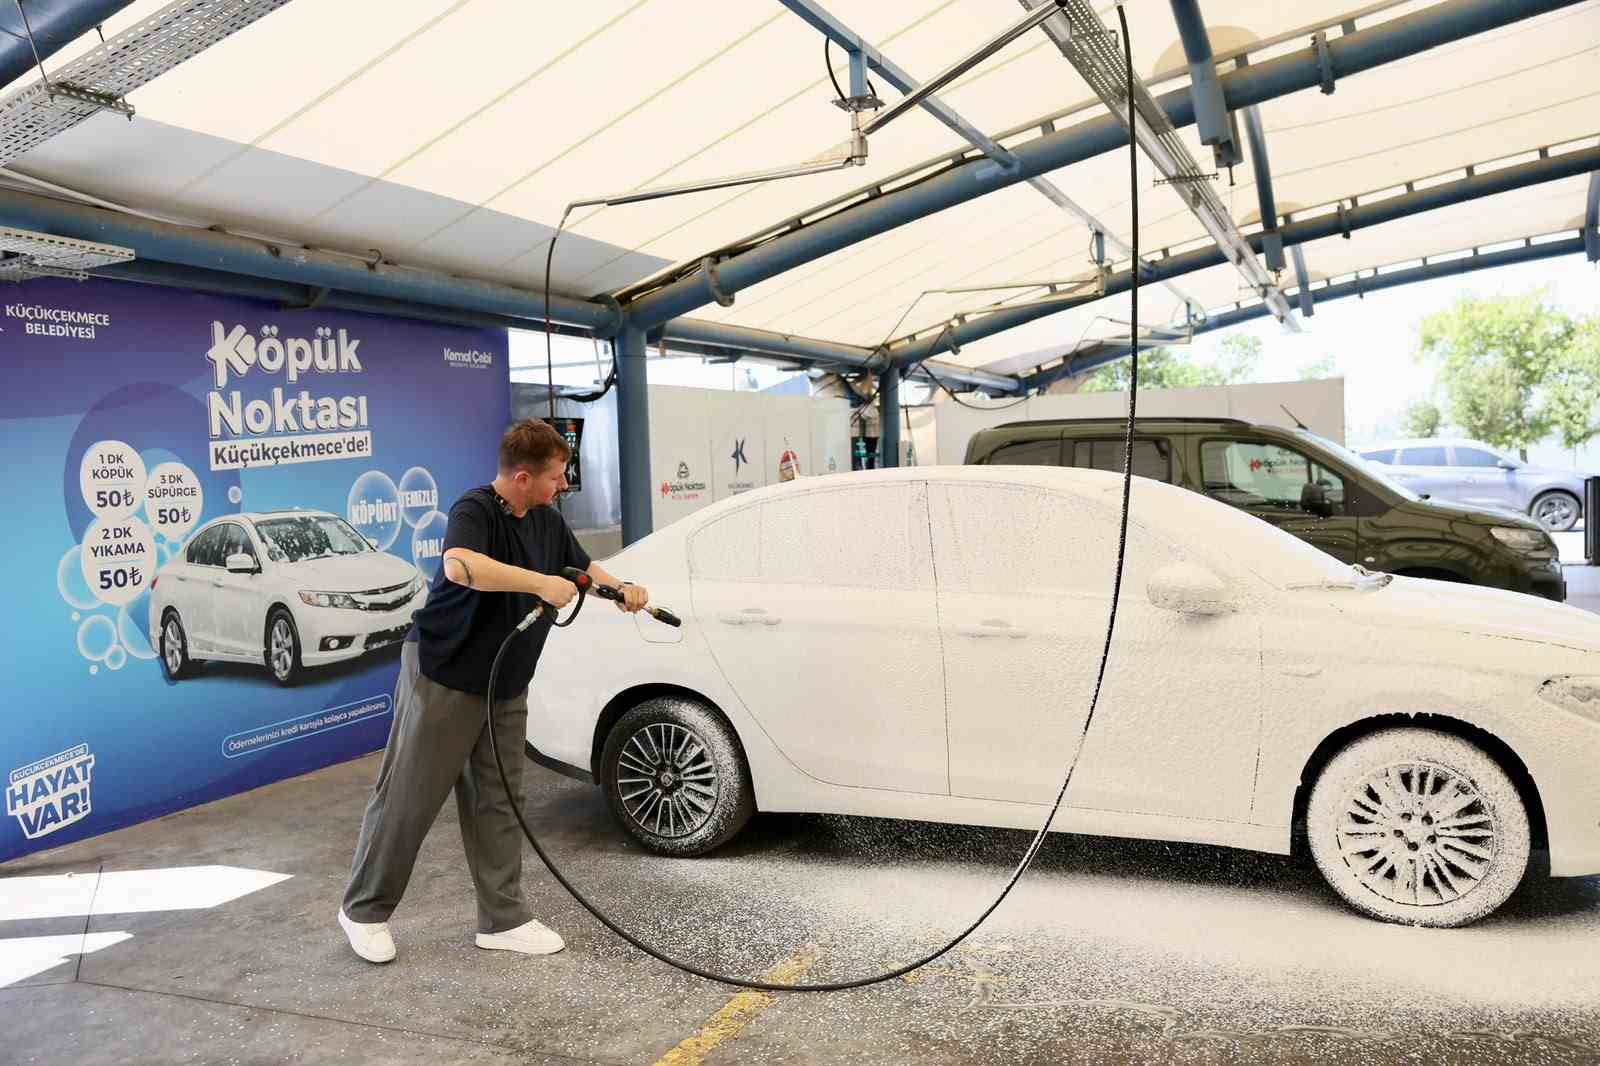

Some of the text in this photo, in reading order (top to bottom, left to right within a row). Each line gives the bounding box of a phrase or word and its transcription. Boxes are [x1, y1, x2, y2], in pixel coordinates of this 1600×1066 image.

[5, 303, 110, 326] KÜÇÜKÇEKMECE
[25, 321, 96, 339] BELEDİYESİ
[206, 320, 363, 388] Köpük
[208, 387, 369, 439] Noktası
[99, 454, 125, 465] 1 DK
[214, 436, 369, 468] Küçükçekmece'de!
[92, 467, 134, 480] KÖPÜK
[160, 474, 184, 484] 3 DK
[148, 487, 197, 499] SÜPÜRGE
[351, 498, 398, 525] KÖPÜRT
[102, 527, 133, 540] 2 DK
[90, 542, 146, 558] YIKAMA
[9, 757, 93, 813] HAYAT
[20, 786, 89, 836] VAR!
